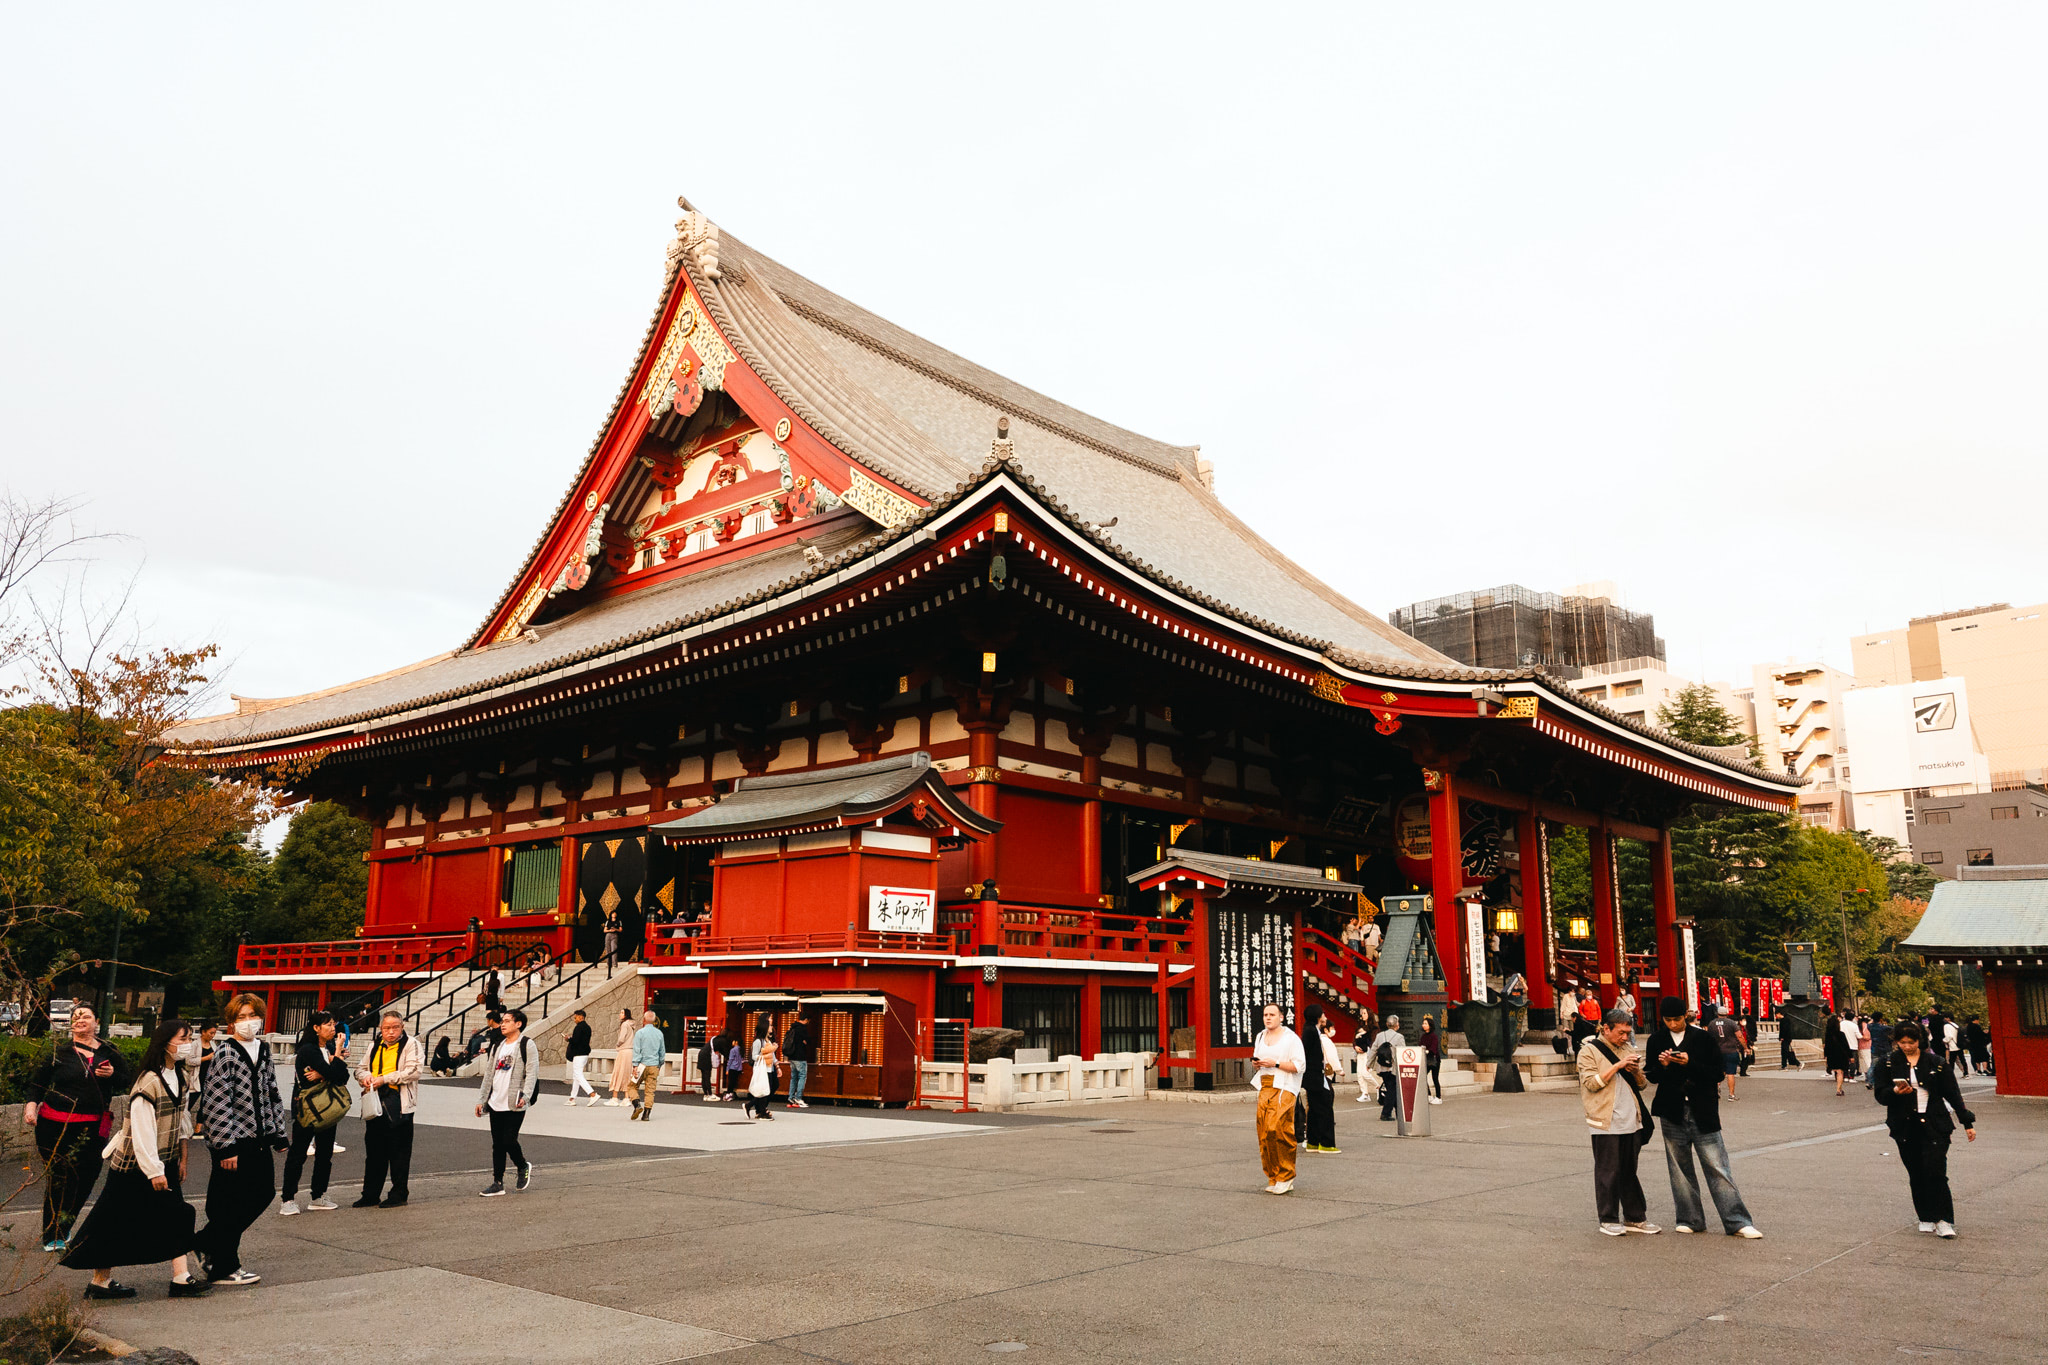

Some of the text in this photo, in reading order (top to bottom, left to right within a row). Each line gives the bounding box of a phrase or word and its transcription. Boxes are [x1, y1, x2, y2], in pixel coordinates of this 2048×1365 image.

[1918, 760, 1965, 770] matsukiyo
[878, 898, 927, 925] 朱印所
